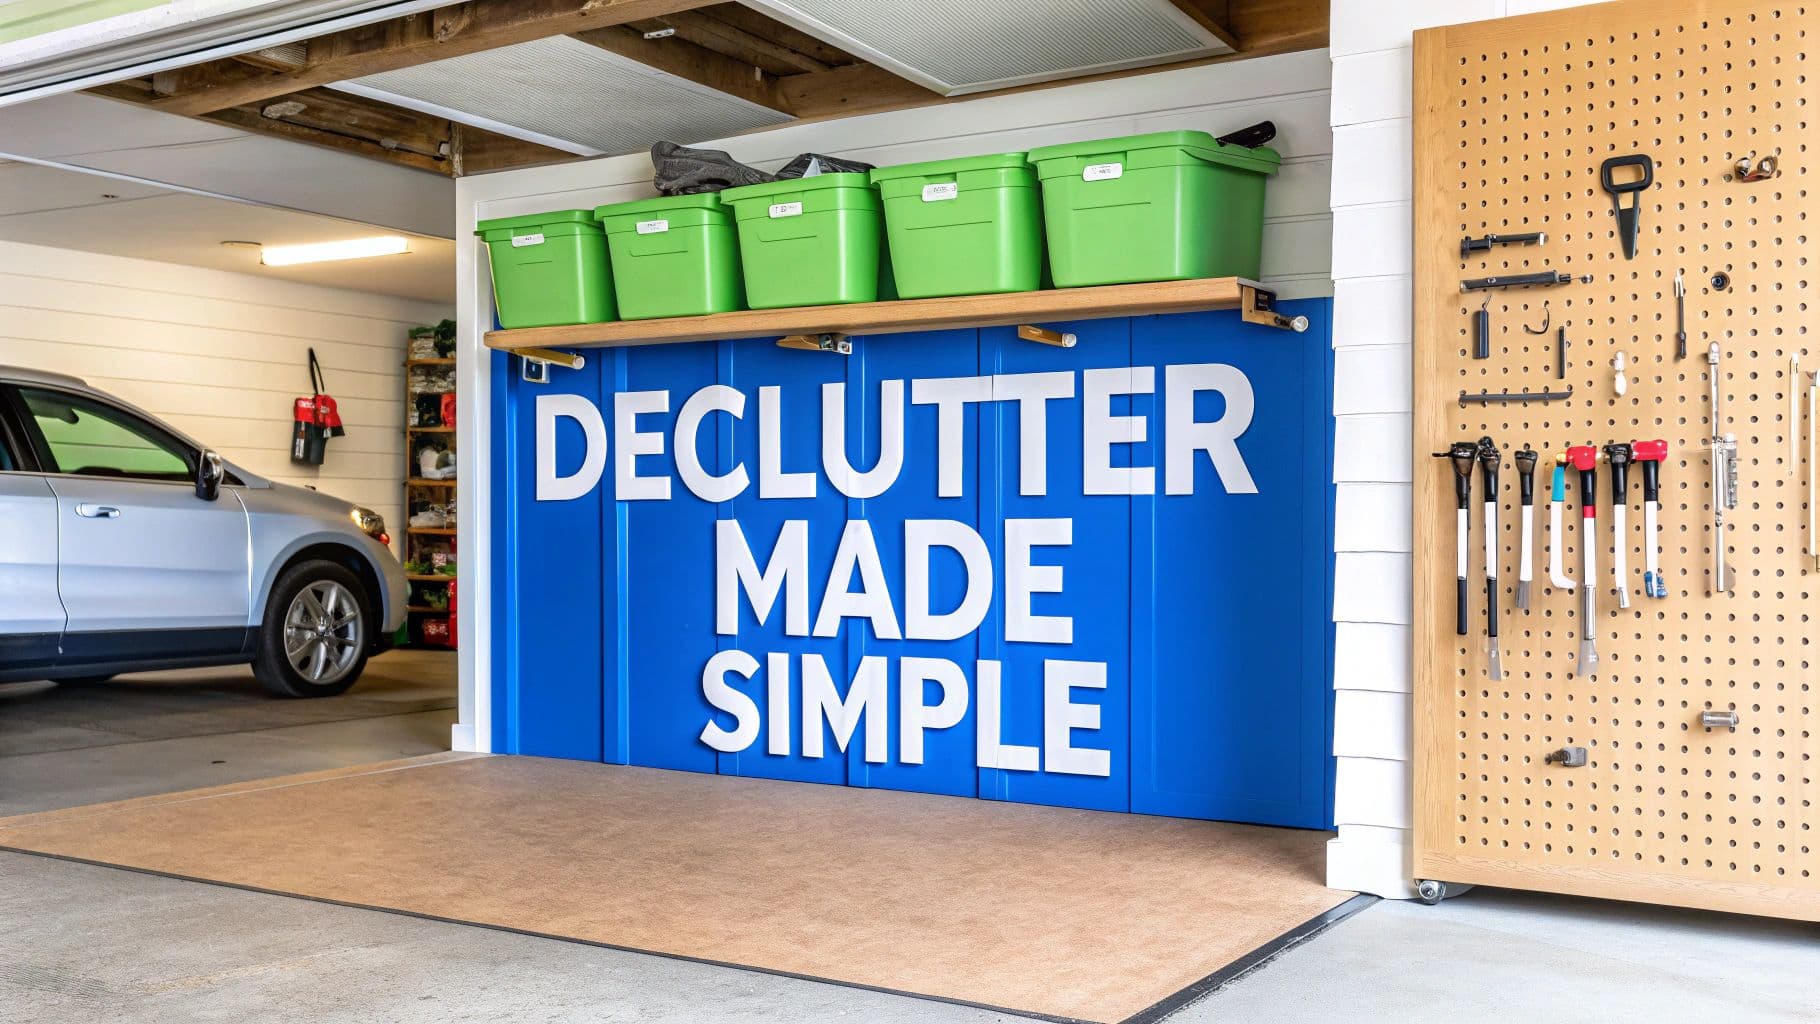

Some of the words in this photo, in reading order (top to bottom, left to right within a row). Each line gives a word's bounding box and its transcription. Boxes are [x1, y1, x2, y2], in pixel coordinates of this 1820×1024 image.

[536, 363, 1258, 502] DECLUTTER
[717, 518, 1073, 644] MADE
[700, 650, 1111, 777] SIMPLE
